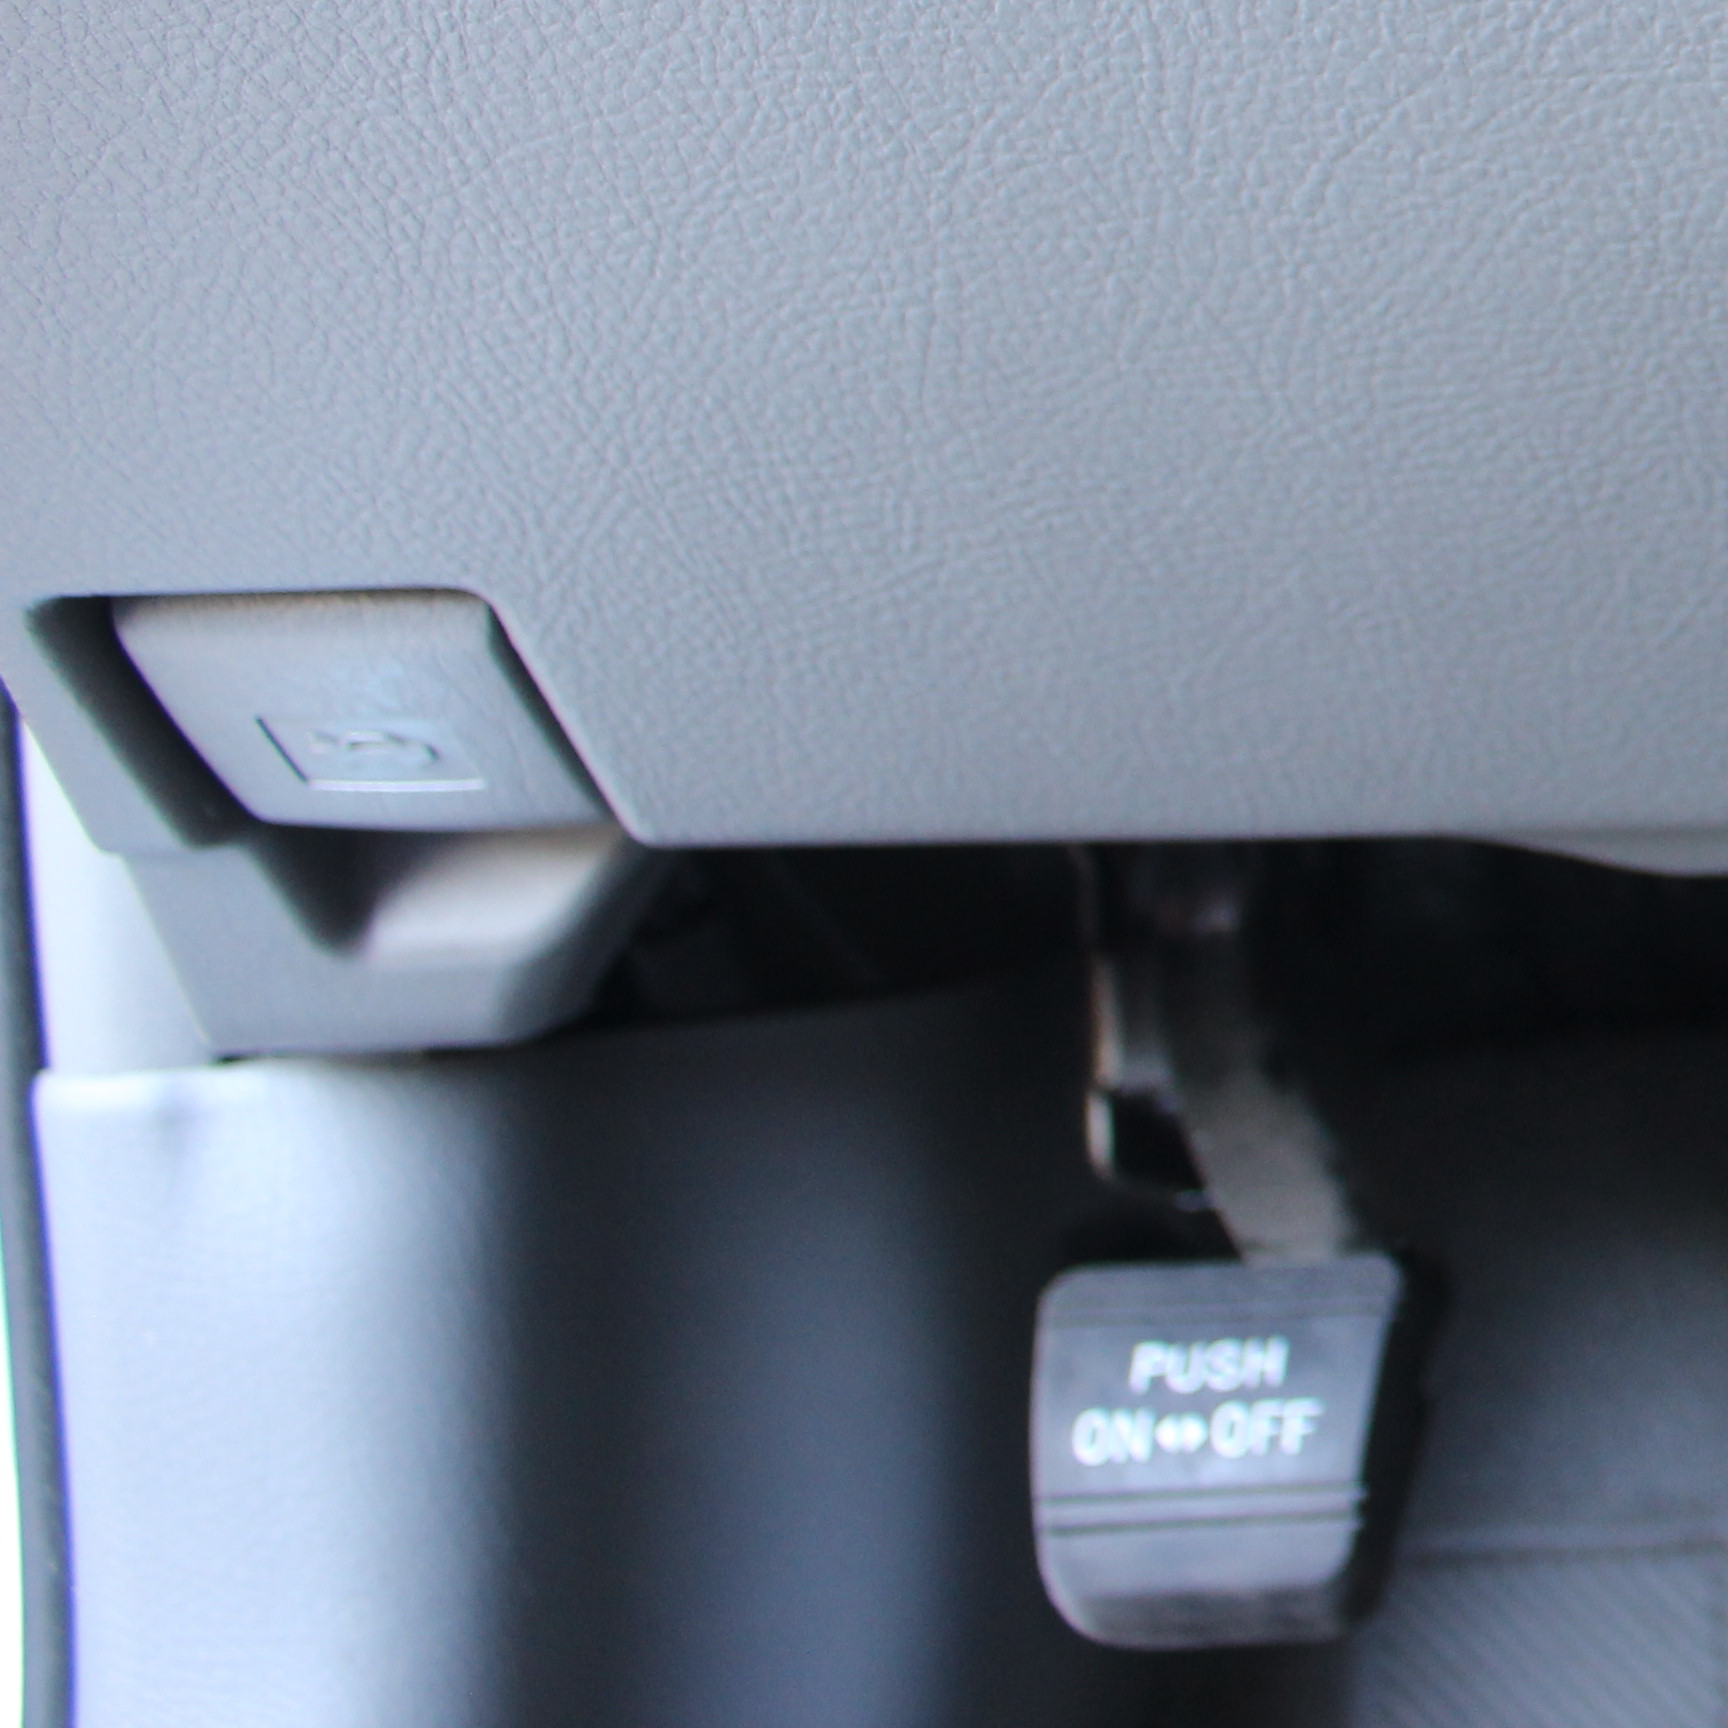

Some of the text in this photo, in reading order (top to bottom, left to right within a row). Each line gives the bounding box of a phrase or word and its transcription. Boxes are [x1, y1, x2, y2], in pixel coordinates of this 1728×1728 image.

[1128, 1335, 1291, 1395] PUSH
[1071, 1396, 1326, 1466] ON OFF
